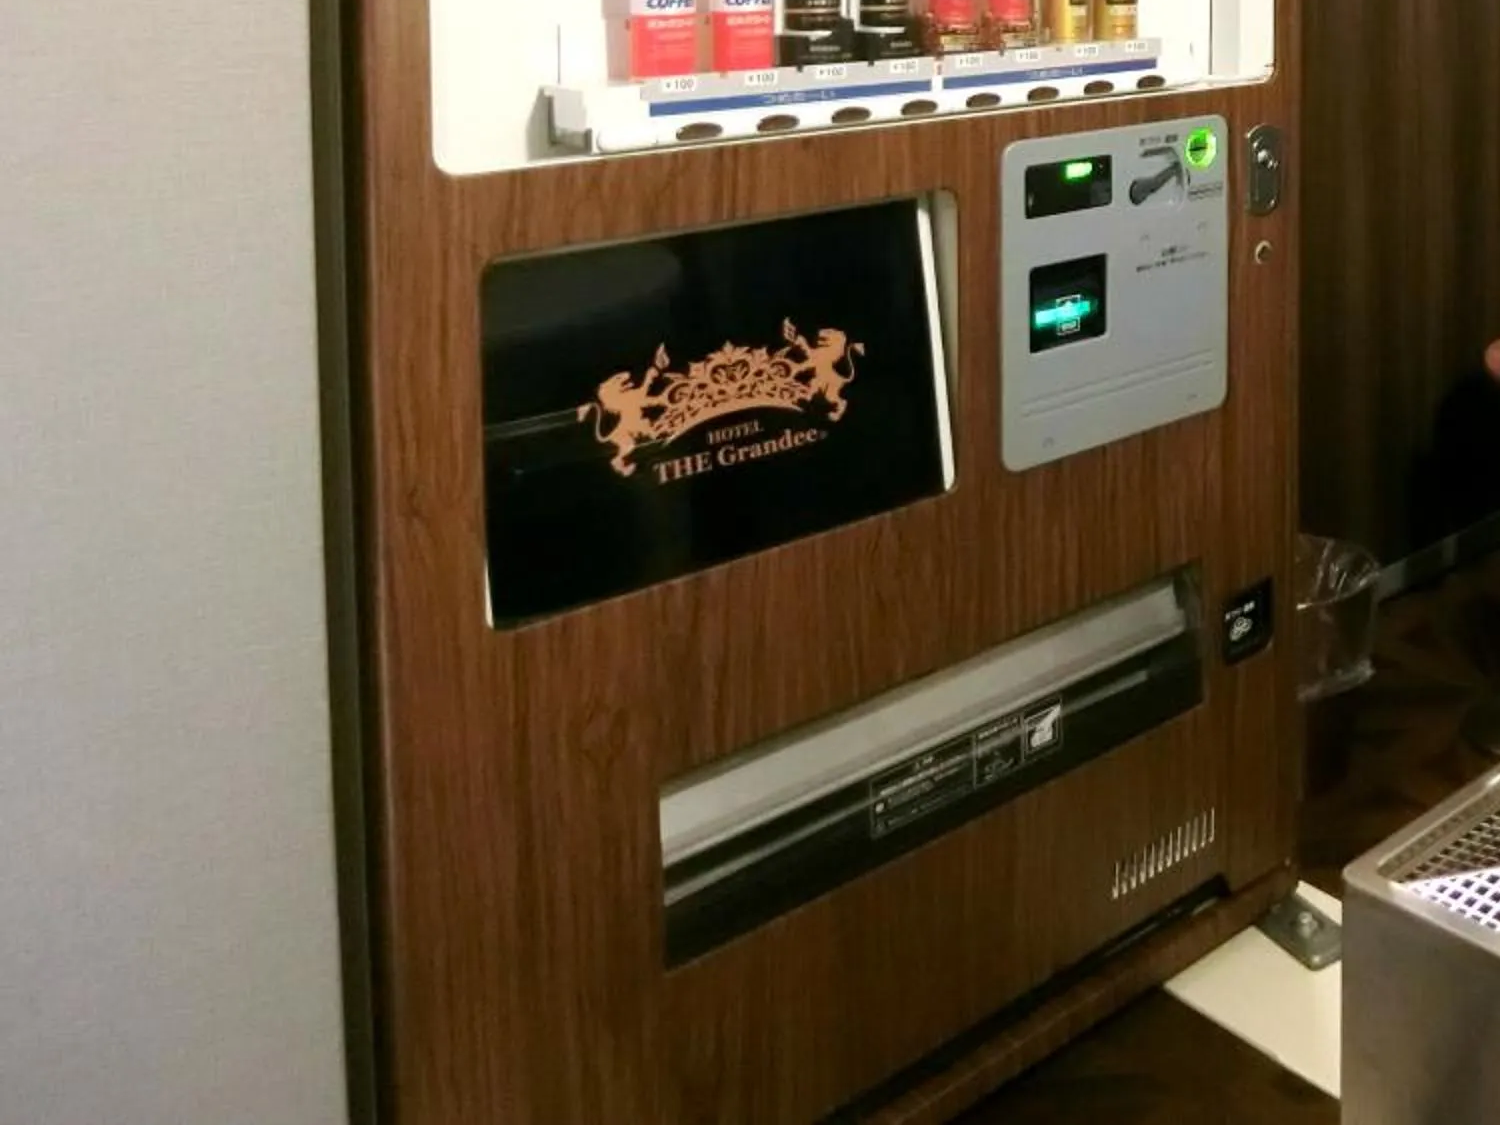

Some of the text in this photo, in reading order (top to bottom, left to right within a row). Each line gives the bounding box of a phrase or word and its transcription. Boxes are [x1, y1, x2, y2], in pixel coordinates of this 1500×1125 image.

[707, 419, 764, 446] HOTEL
[652, 427, 818, 486] THE Grandee
